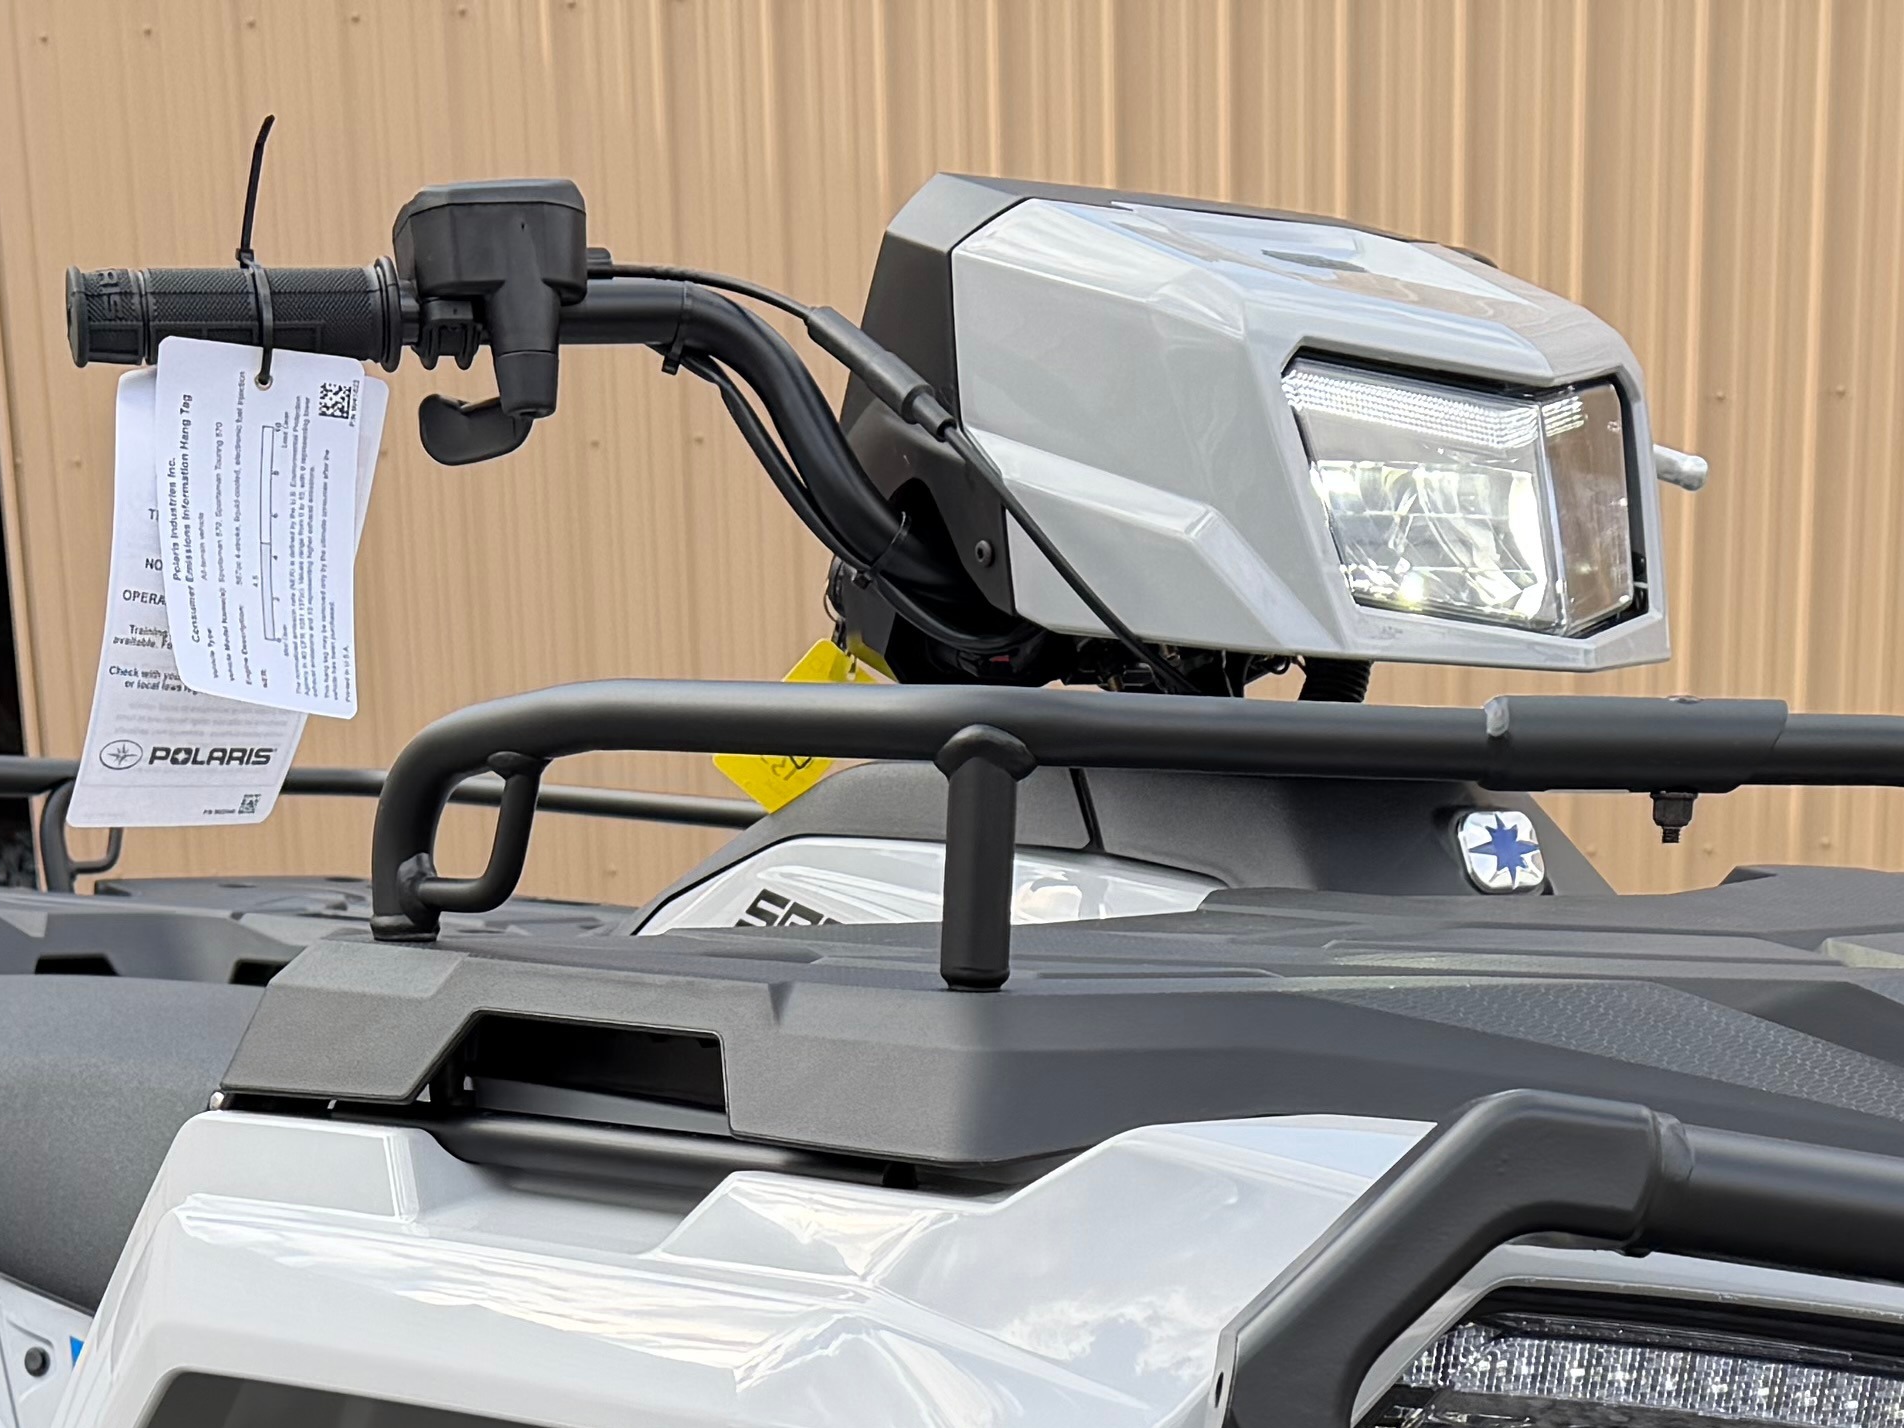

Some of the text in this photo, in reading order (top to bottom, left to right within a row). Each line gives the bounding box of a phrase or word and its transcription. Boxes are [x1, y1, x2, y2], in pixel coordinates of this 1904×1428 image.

[237, 371, 245, 405] injection
[235, 408, 243, 423] fuel
[214, 440, 224, 470] Touring
[234, 425, 242, 466] electronic
[215, 473, 223, 517] Sportsman
[167, 457, 181, 580] Polaris Industries Inc.
[180, 394, 200, 643] Consumer Emissions Information Hang Tag
[216, 540, 225, 582] Sportsman
[109, 665, 139, 679] Check
[141, 668, 161, 680] with
[124, 680, 135, 688] or
[137, 679, 160, 691] local
[148, 746, 273, 766] POLARIS
